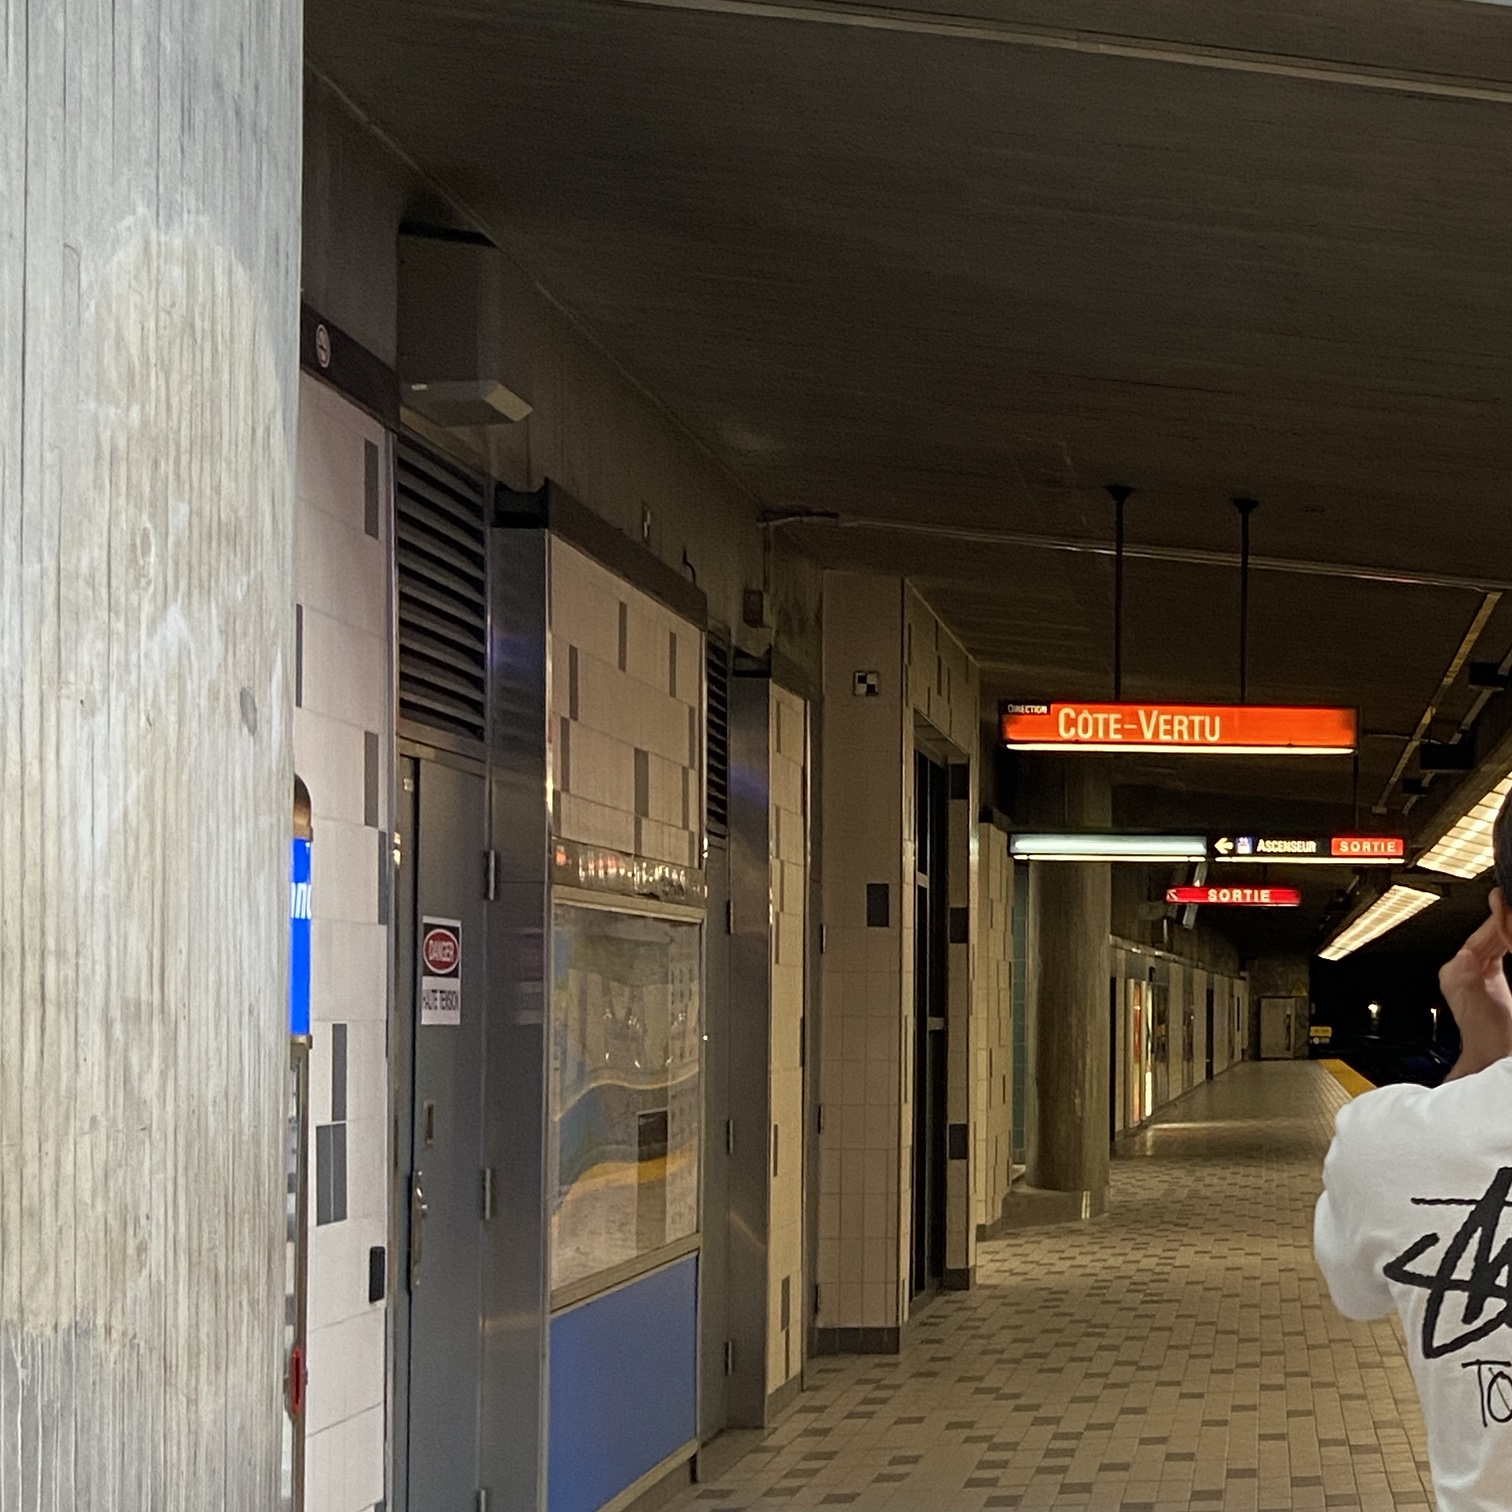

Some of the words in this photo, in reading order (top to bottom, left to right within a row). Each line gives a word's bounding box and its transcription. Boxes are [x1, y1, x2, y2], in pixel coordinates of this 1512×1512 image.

[1058, 707, 1221, 741] CÔTE-VERTU
[1257, 839, 1317, 853] ASCENSEUR
[1340, 840, 1396, 853] SORTIE
[1207, 888, 1271, 903] SORTIE
